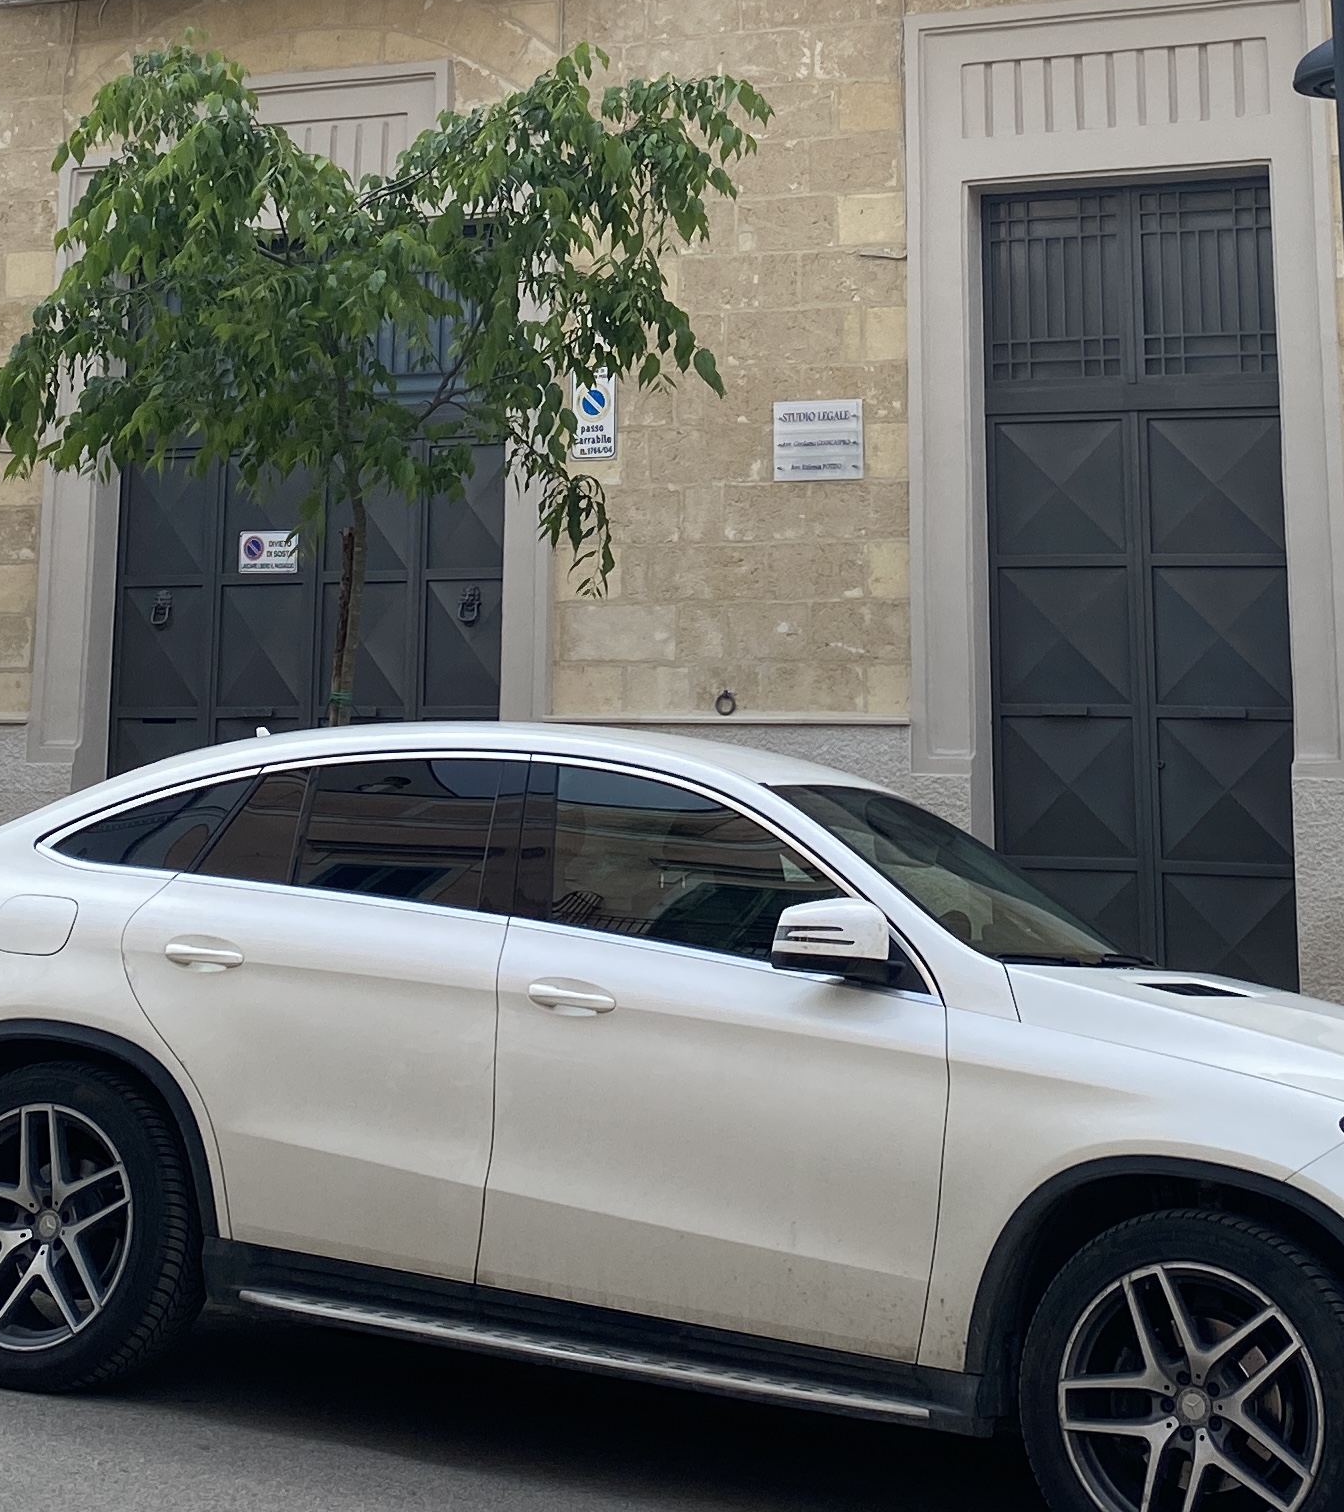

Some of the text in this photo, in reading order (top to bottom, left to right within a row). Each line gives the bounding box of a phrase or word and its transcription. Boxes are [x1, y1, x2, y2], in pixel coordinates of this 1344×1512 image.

[782, 411, 850, 422] STUDIO LEGALE
[581, 425, 604, 435] passo
